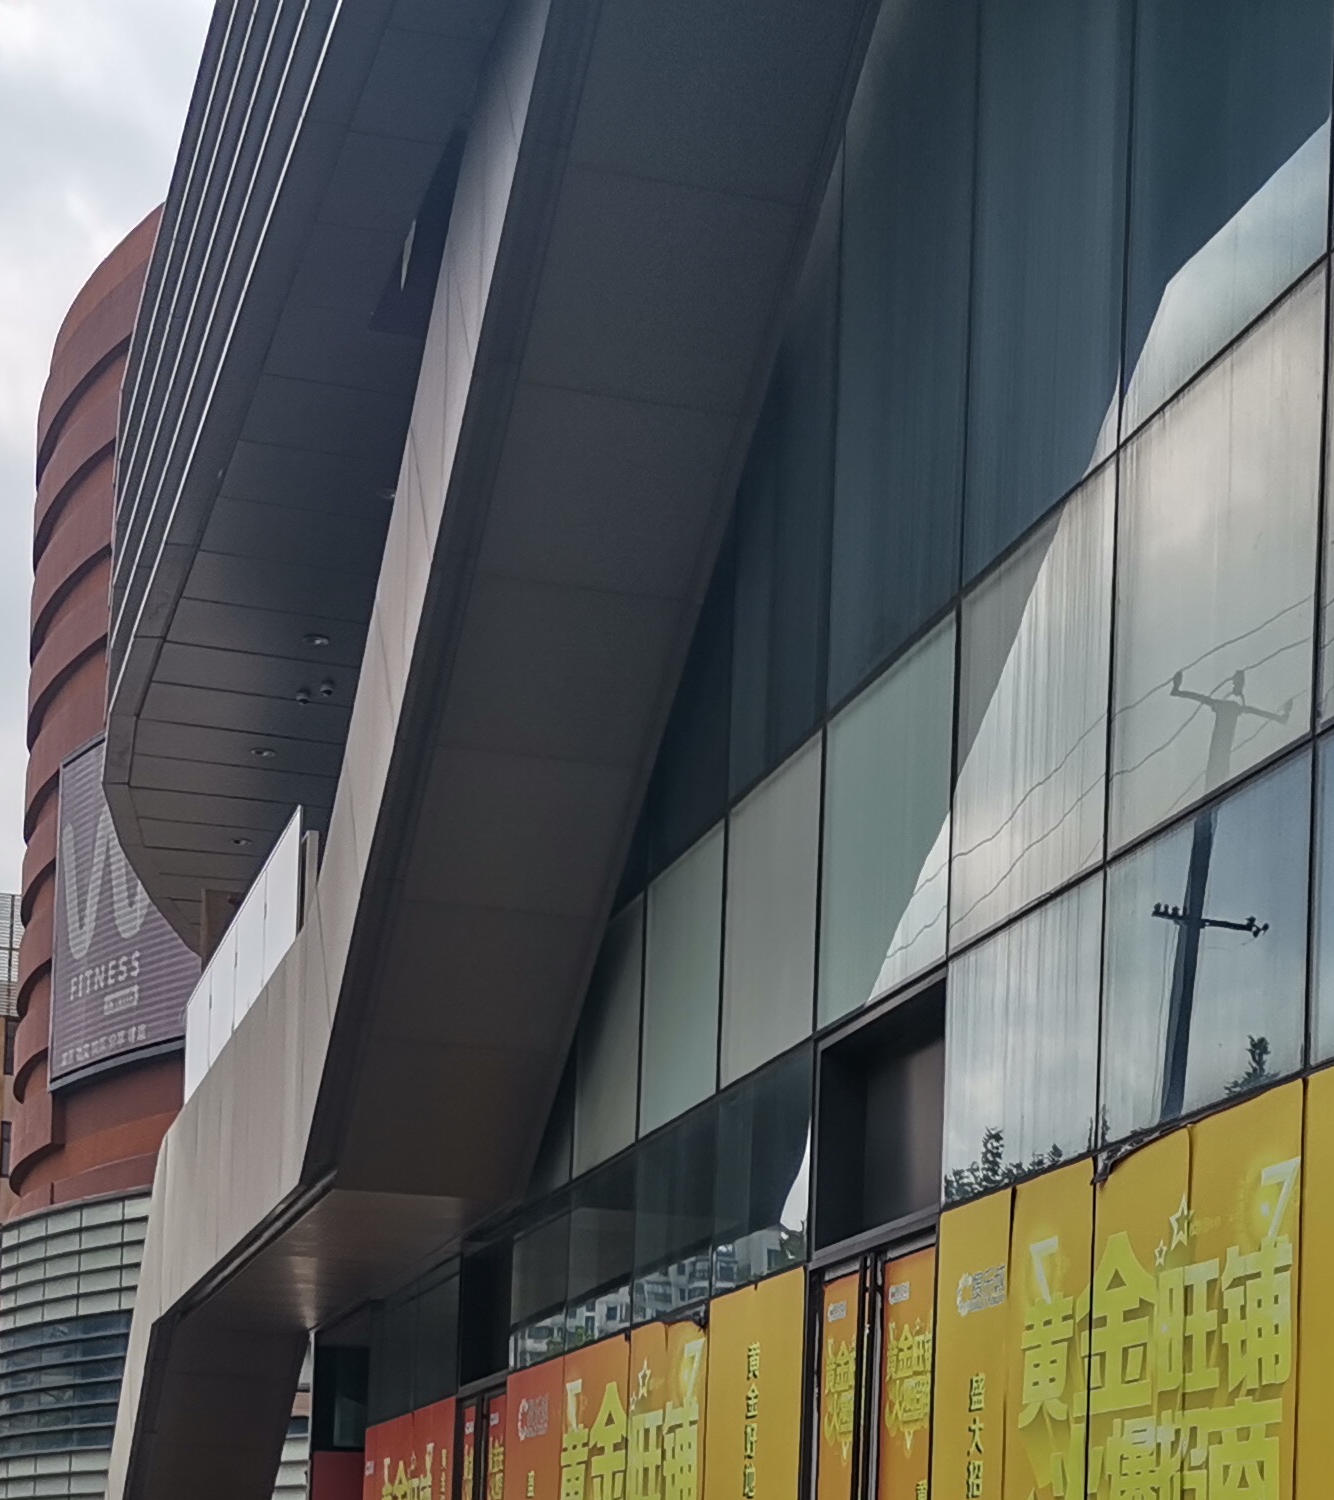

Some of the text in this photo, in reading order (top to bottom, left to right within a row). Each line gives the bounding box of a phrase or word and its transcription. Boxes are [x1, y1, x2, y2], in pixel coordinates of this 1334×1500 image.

[69, 951, 140, 1001] FITNESS
[1018, 1231, 1292, 1429] 黄金旺铺
